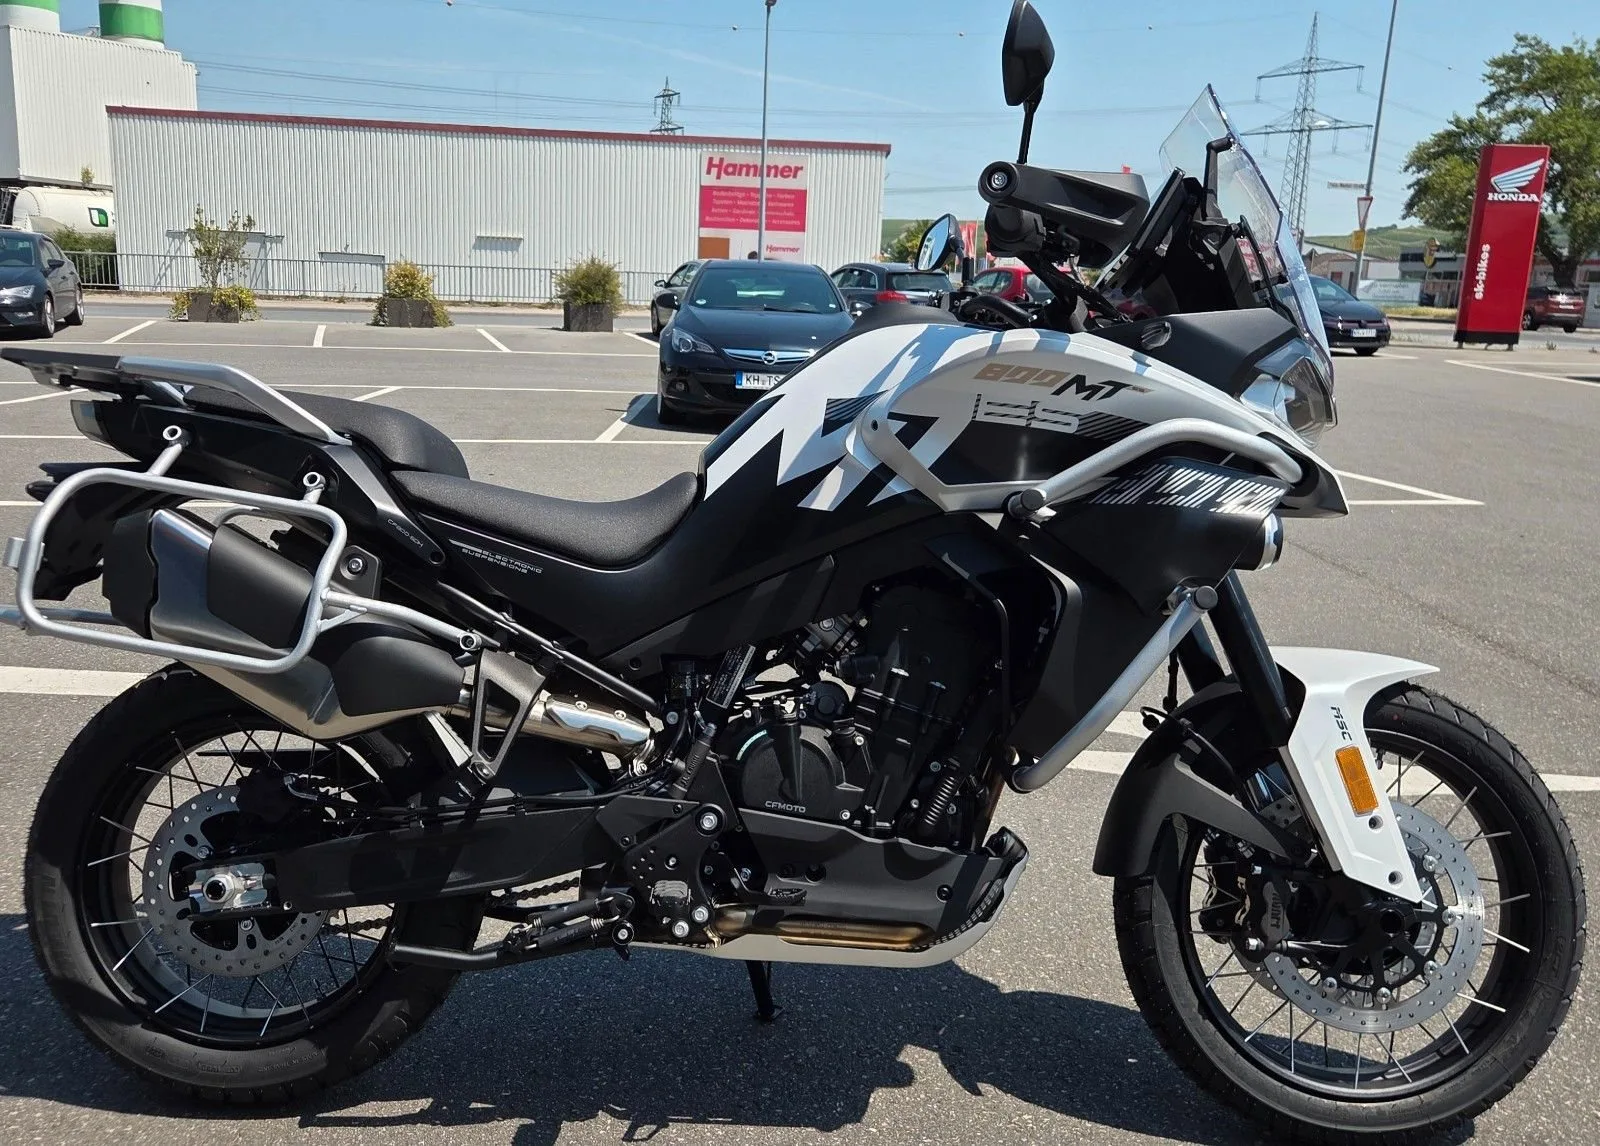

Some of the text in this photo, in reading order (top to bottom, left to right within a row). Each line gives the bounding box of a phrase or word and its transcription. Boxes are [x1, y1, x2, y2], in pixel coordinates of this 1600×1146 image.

[706, 156, 804, 180] Hammer
[1487, 192, 1540, 202] HONDA
[766, 244, 800, 253] Hammer
[745, 374, 760, 386] KH
[461, 548, 528, 574] SUSPENSIONS
[482, 550, 543, 574] ELECTRONIC
[765, 800, 806, 813] CFMOTO
